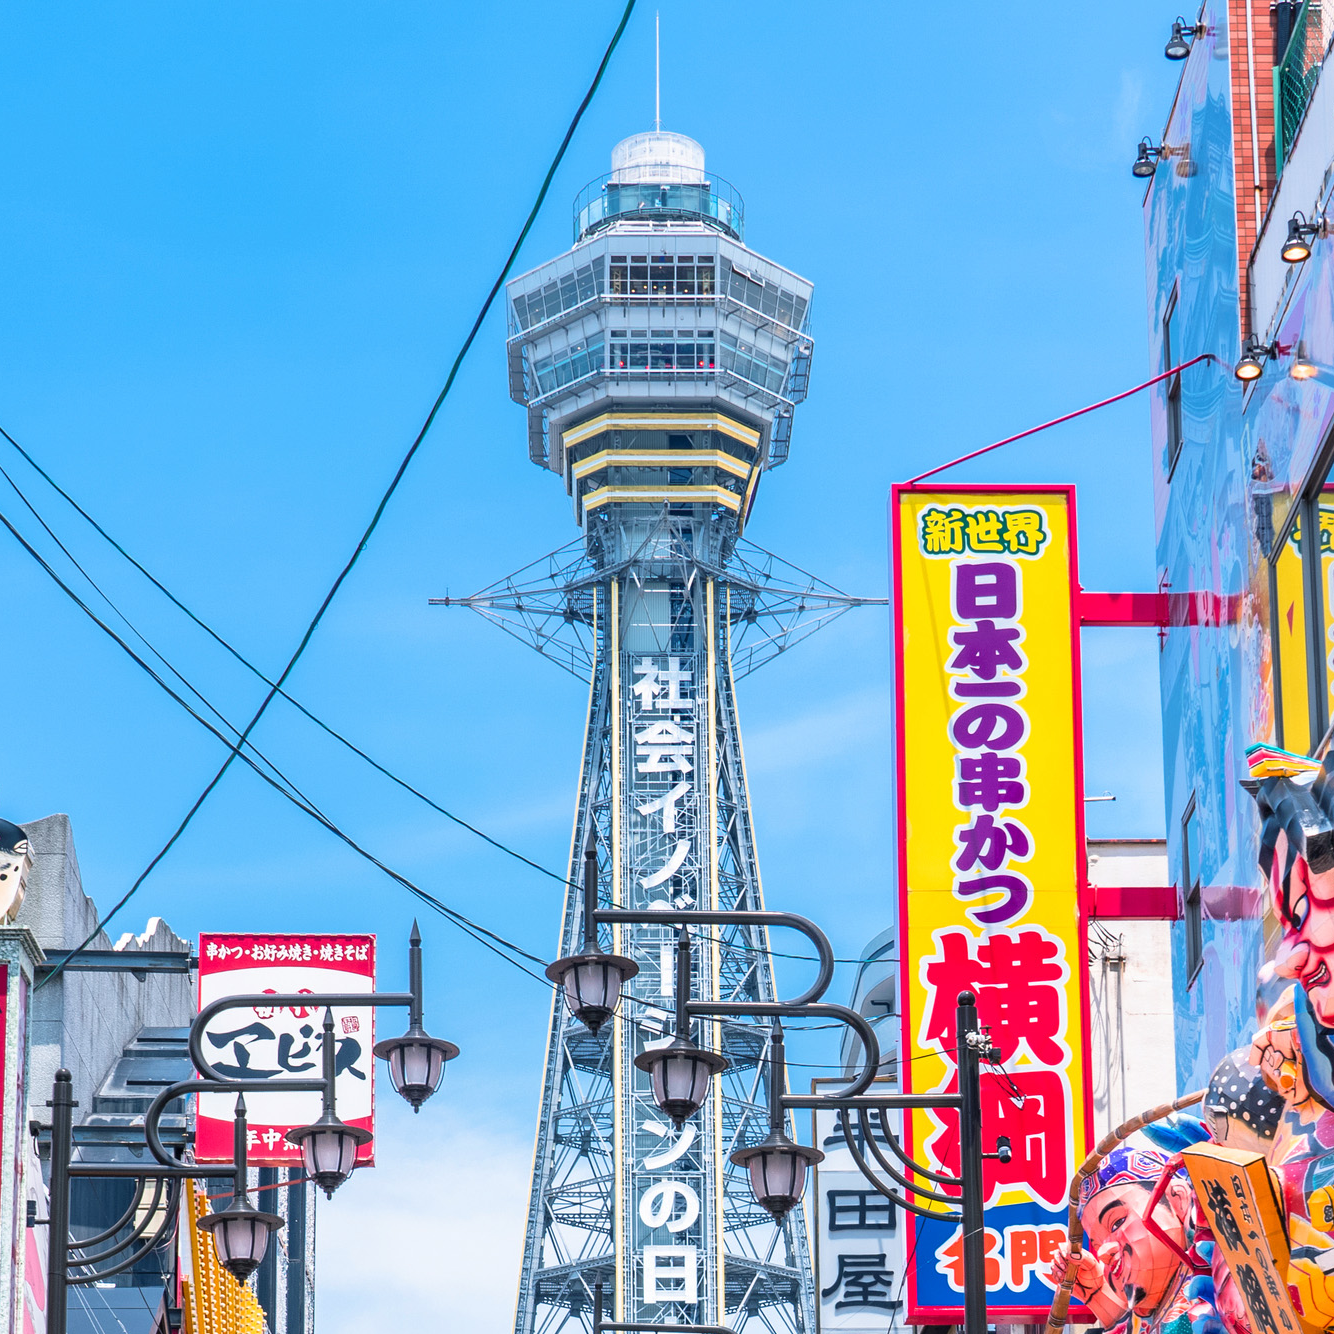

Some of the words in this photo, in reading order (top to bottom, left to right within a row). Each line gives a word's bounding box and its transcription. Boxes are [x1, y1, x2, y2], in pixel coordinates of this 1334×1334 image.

[922, 508, 1048, 556] 新世界
[951, 561, 1031, 925] 日本一の串かつ
